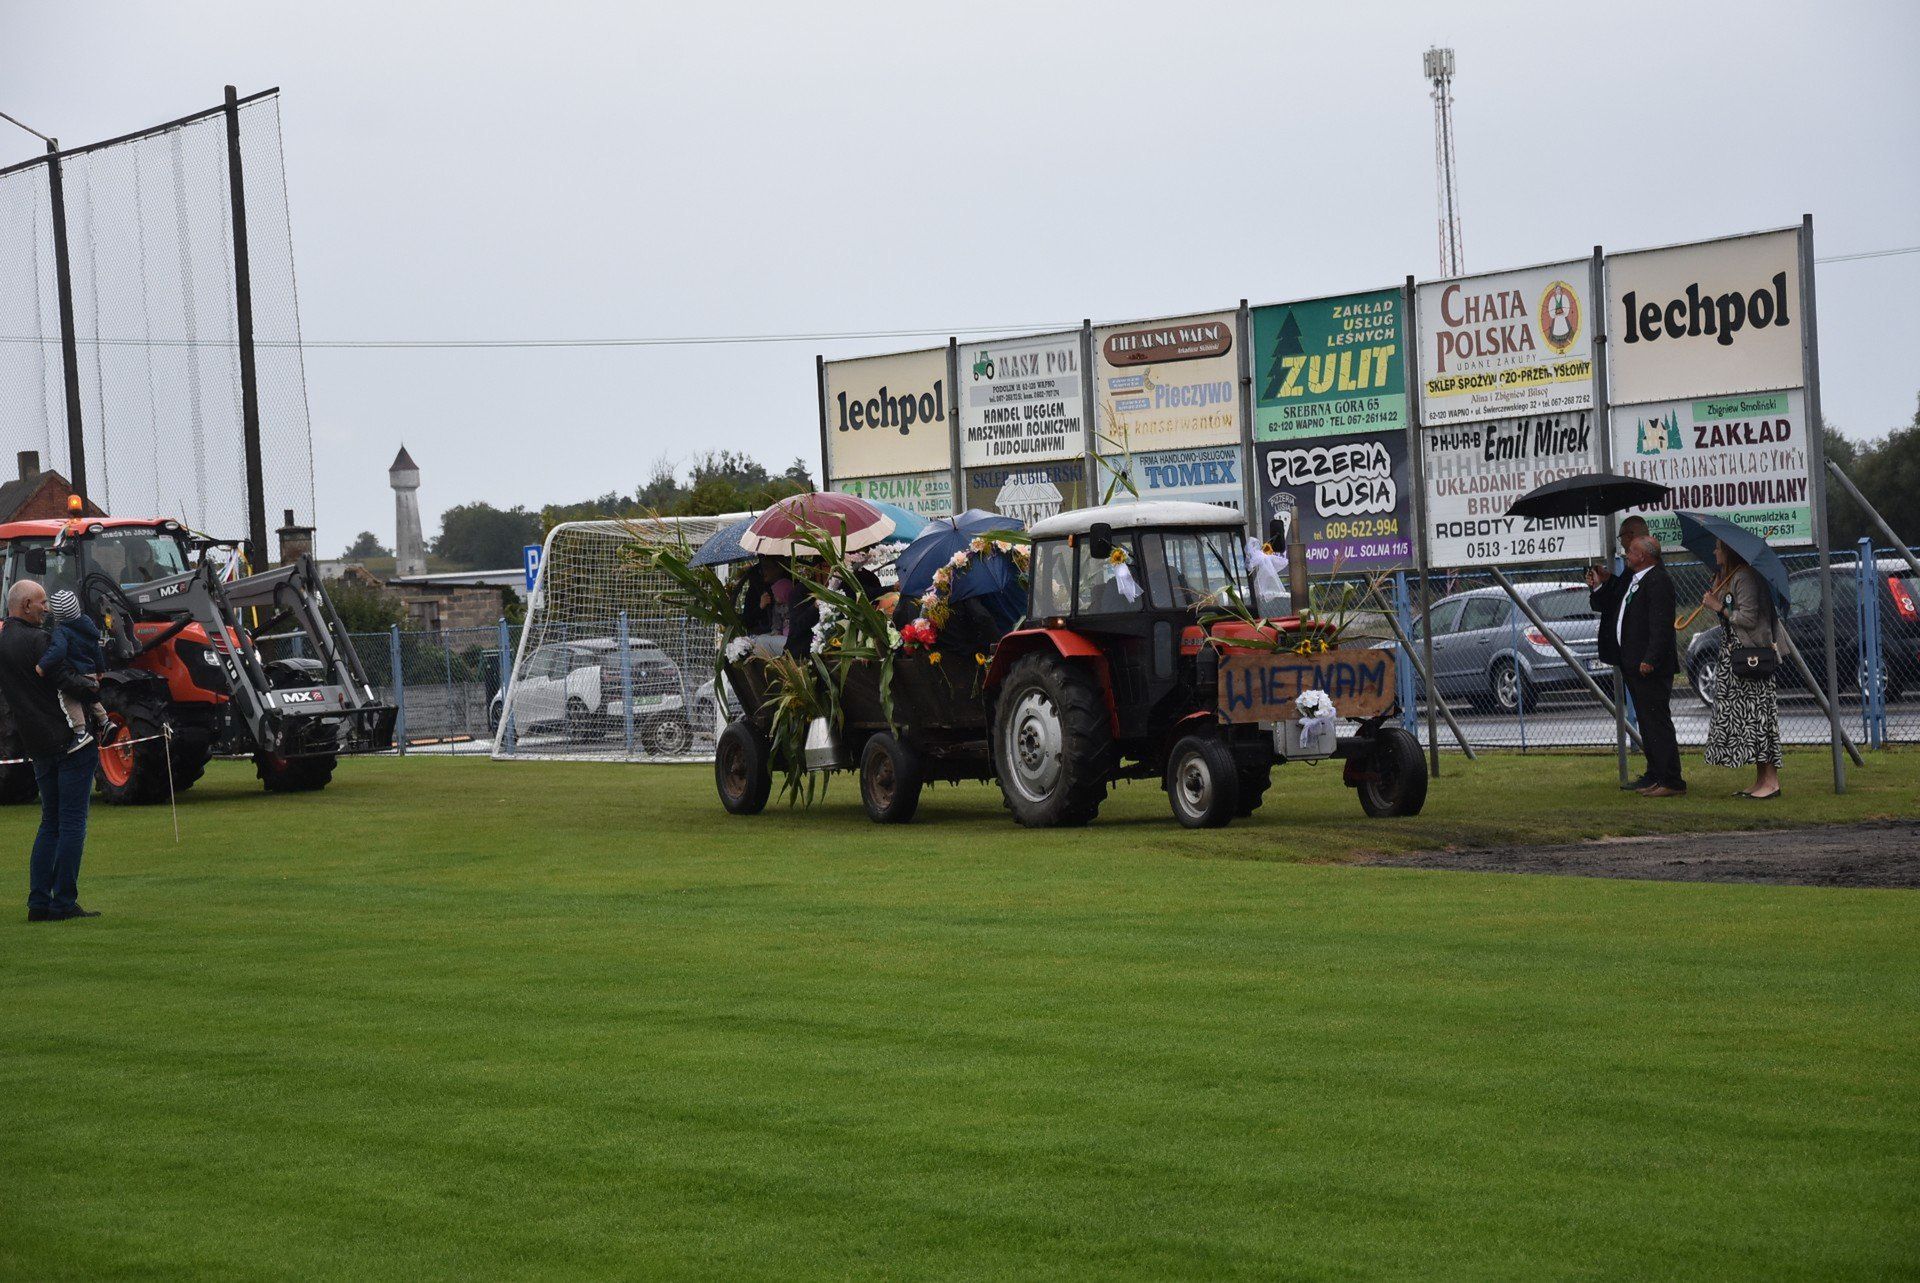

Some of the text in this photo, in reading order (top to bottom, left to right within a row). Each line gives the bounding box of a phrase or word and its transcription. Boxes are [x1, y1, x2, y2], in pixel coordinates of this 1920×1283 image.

[1332, 300, 1393, 318] ZAKŁAD
[1441, 284, 1527, 327] CHATA
[1622, 271, 1790, 346] lechpol
[1343, 313, 1394, 331] USŁUG
[1111, 325, 1219, 351] PIEKARNIA WAPNO
[1436, 323, 1536, 373] POLSKA
[1046, 349, 1077, 373] POL
[1277, 344, 1395, 398] ZULIT
[1457, 354, 1537, 372] UDANE ZAKUPY
[1155, 381, 1232, 409] Pieczywo
[1428, 379, 1456, 393] SKLEP
[1471, 393, 1488, 404] Alina
[1494, 389, 1525, 402] Zbigniew
[837, 379, 945, 435] lechpol
[984, 406, 1020, 424] HANDEL
[1283, 398, 1379, 419] SREBRNA GÓRA 65
[1429, 410, 1447, 420] 62-120
[1448, 407, 1469, 419] WAPNO
[1530, 400, 1537, 409] 32
[1708, 399, 1777, 418] Zbigniew Smoliński
[968, 417, 1080, 442] MASZYNAMI ROLNICZYMI
[1269, 420, 1293, 432] 62-120
[1296, 418, 1324, 430] WAPNO
[1693, 419, 1791, 449] ZAKŁAD
[986, 436, 1065, 456] I BUDOWLANYMI
[1484, 420, 1529, 462] Emil
[1534, 413, 1590, 458] Mirek
[1140, 450, 1236, 466] FIRMA HANDLOWO-USŁUGOWA
[1271, 449, 1386, 480] PIZZERIA
[973, 464, 1082, 489] SKLEP JUBILERSKI
[1145, 460, 1237, 489] TOMEX
[1436, 472, 1526, 497] UKŁADANIE
[869, 479, 922, 500] ROLNIK
[1321, 481, 1390, 508] LUSIA
[1326, 519, 1398, 539] 609-622-994
[1436, 516, 1598, 539] ROBOTY ZIEMNE
[1734, 511, 1789, 524] Grunwaldzka
[1792, 511, 1797, 520] 4
[1306, 543, 1408, 560] APNO UL. SOLNA 11/5
[527, 549, 539, 578] P
[160, 585, 179, 597] MX
[282, 691, 310, 703] MX
[1226, 660, 1386, 712] WIETNAM
